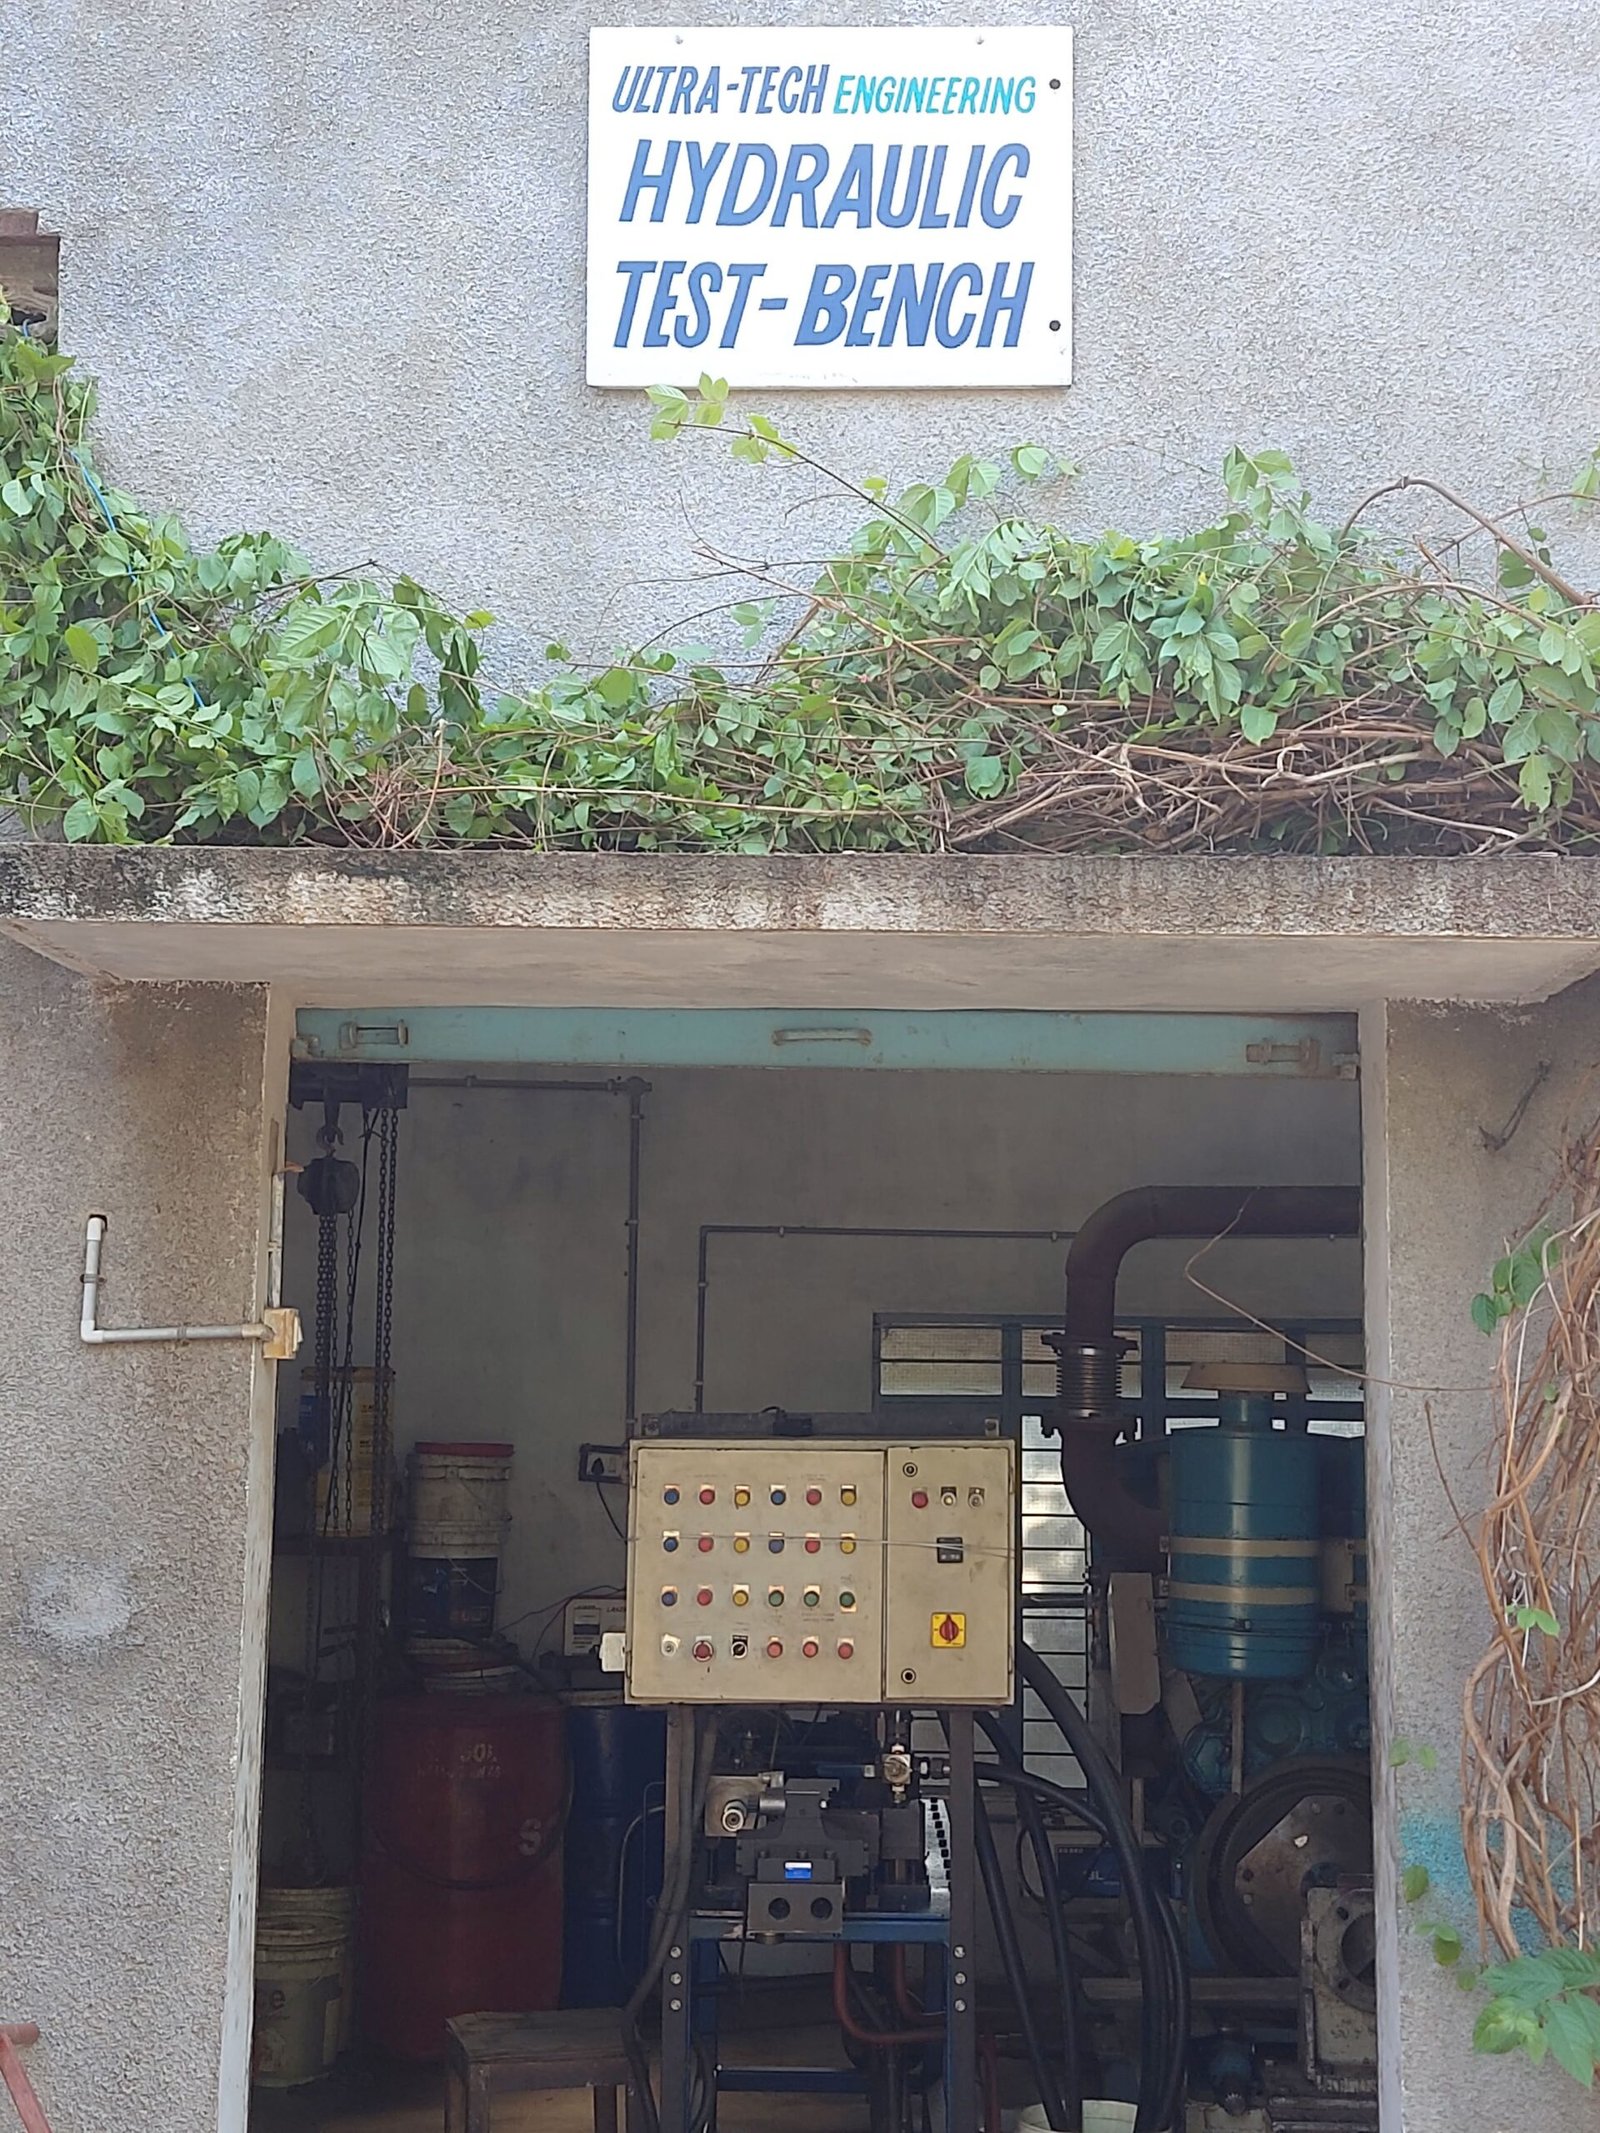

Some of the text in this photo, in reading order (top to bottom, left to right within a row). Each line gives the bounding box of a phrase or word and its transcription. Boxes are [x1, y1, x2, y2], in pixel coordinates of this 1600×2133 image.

[612, 65, 1036, 115] ULTRA-TECH ENGINEERING
[619, 139, 1031, 229] HYDRAULIC
